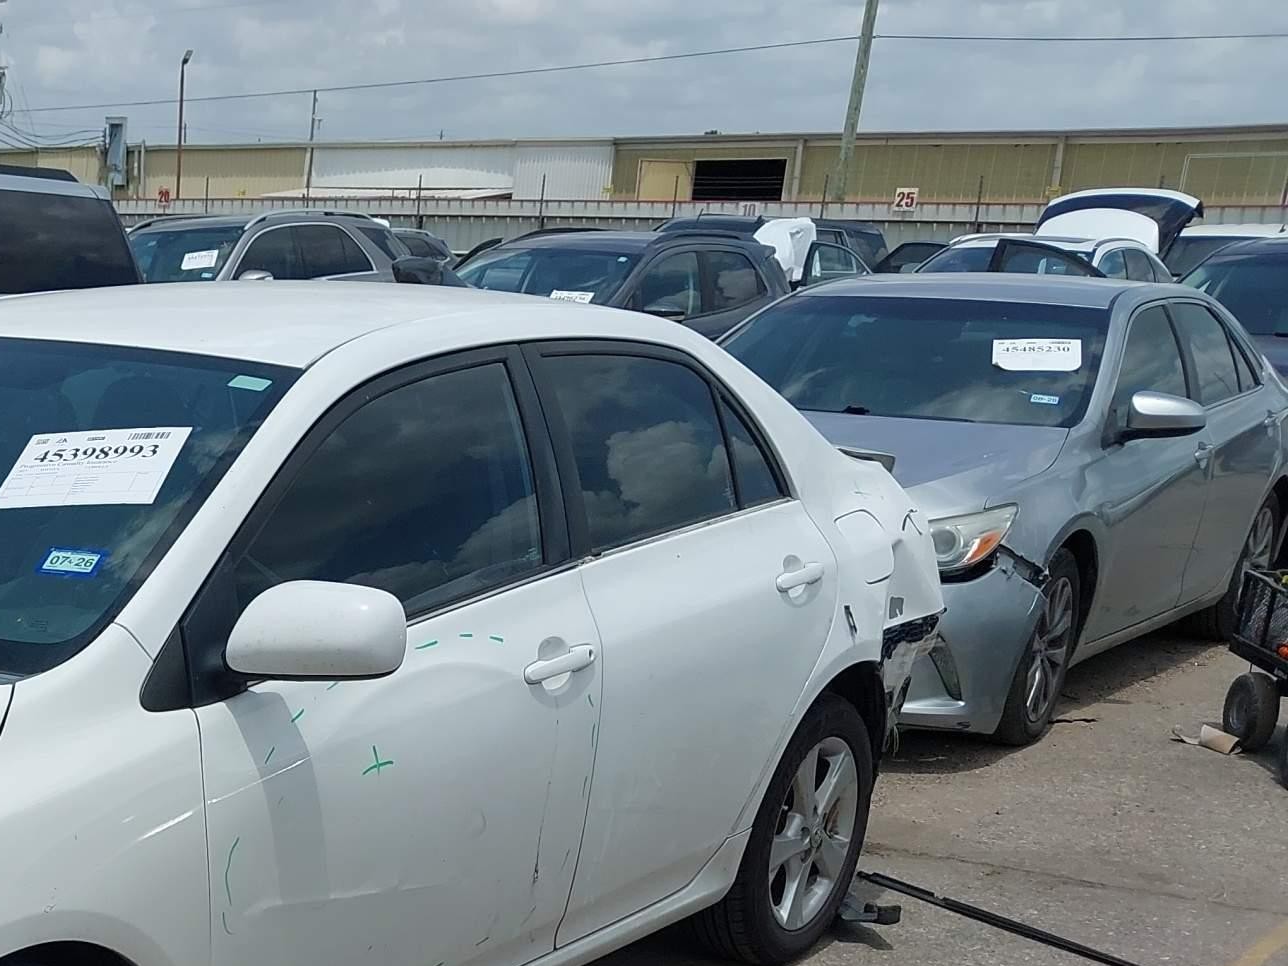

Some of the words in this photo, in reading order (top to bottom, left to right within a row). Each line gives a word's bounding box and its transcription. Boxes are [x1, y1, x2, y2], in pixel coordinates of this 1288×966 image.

[158, 190, 170, 203] 20
[896, 191, 915, 208] 25
[34, 444, 160, 463] 45398993
